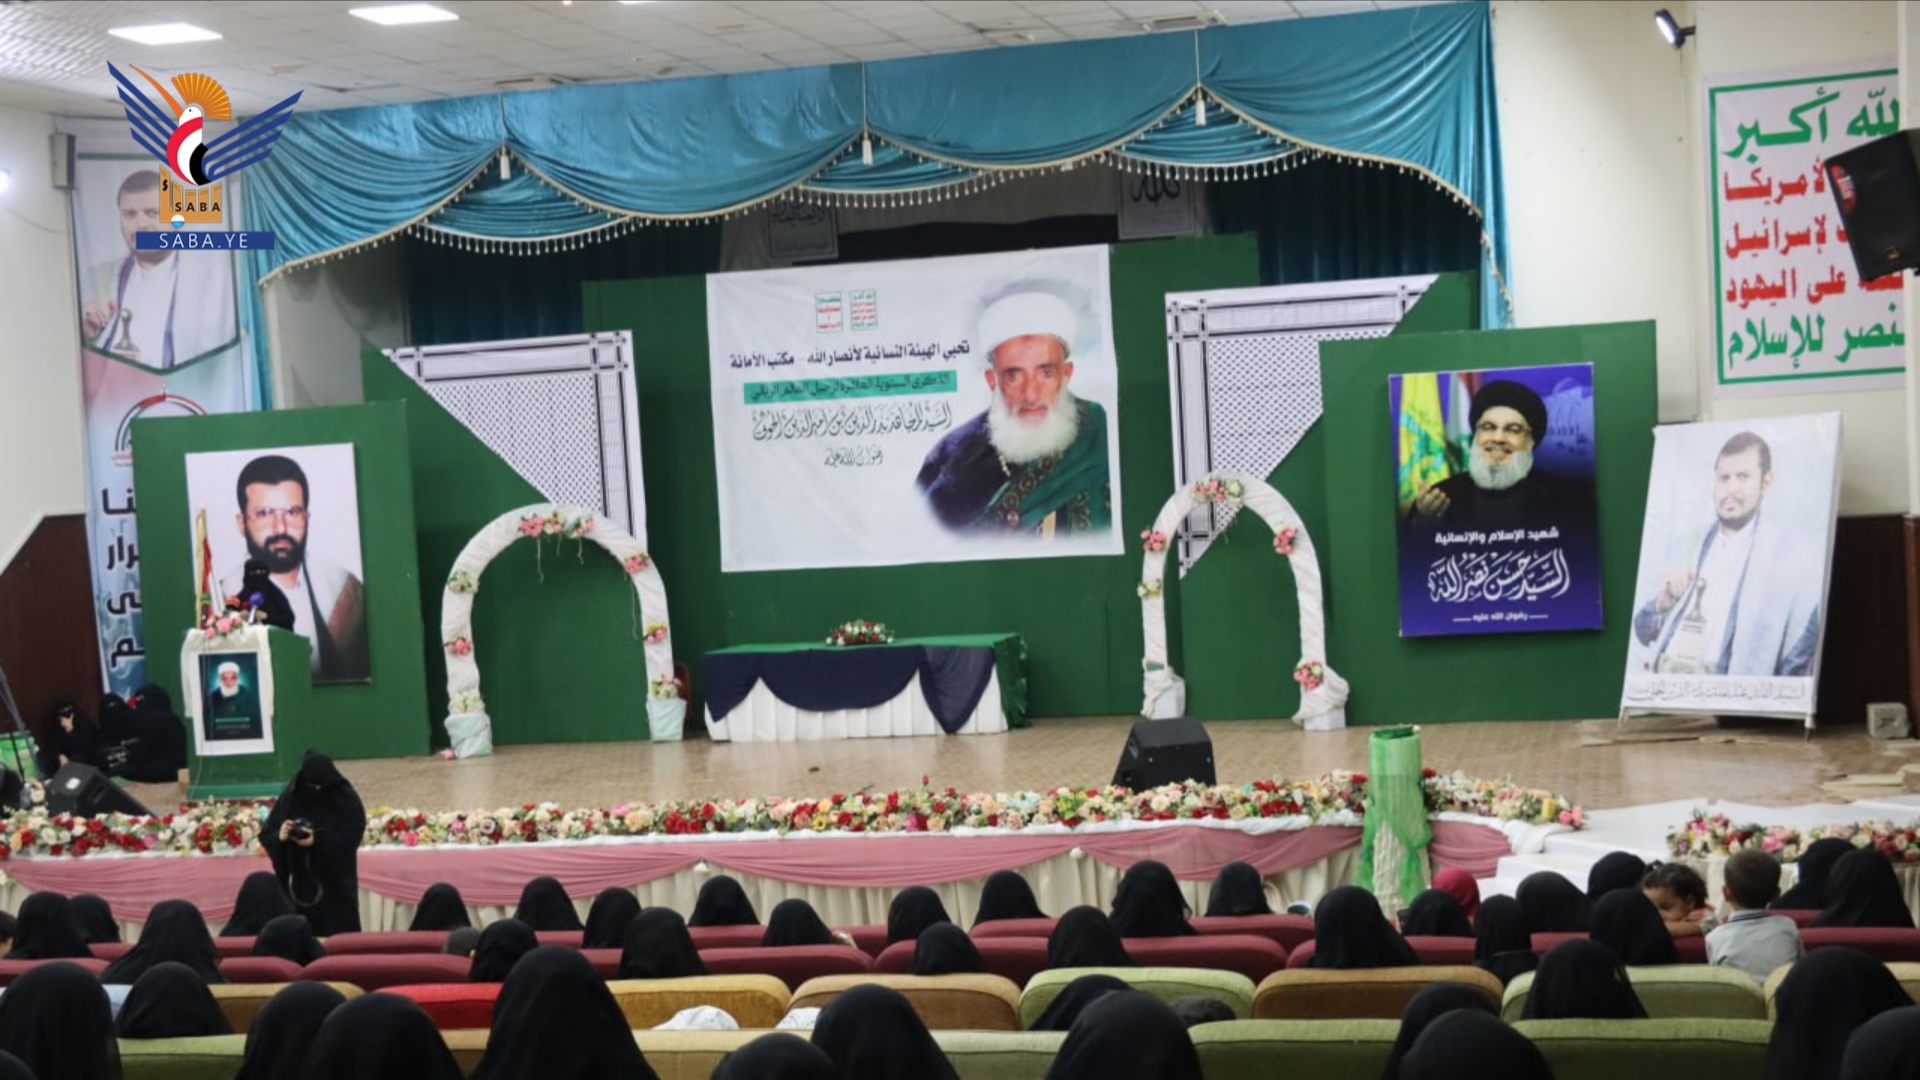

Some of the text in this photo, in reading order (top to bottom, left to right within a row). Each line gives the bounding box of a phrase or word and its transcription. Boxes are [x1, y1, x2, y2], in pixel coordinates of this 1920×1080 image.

[1721, 87, 1900, 165] لله أكبر
[1725, 213, 1827, 261] لإسرائيل
[1726, 267, 1797, 311] اليهود
[1806, 264, 1846, 305] على
[864, 344, 907, 364] النسائية
[943, 339, 971, 360] تحيي
[1728, 302, 1905, 371] نصر للإسلام
[767, 350, 795, 370] مكتب
[1526, 525, 1559, 542] شهيد
